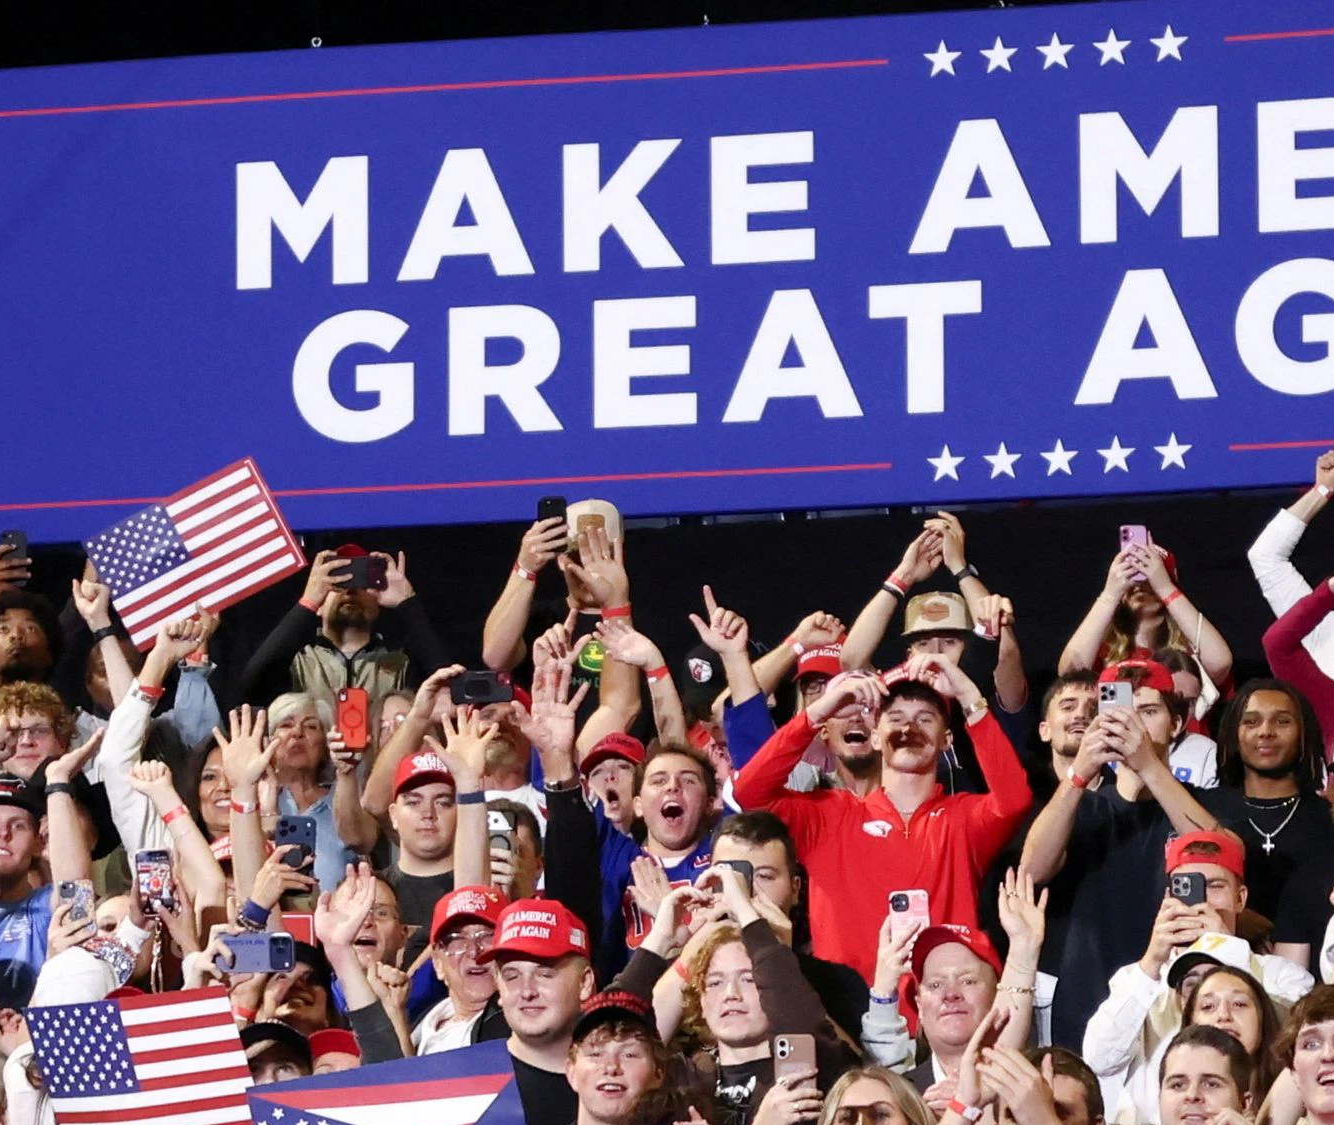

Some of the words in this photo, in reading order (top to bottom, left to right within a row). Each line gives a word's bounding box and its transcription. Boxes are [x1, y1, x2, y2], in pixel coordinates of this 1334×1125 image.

[236, 131, 816, 290] MAKE
[292, 280, 982, 443] GREAT
[516, 910, 557, 926] AMERICA
[520, 925, 551, 938] AGAIN
